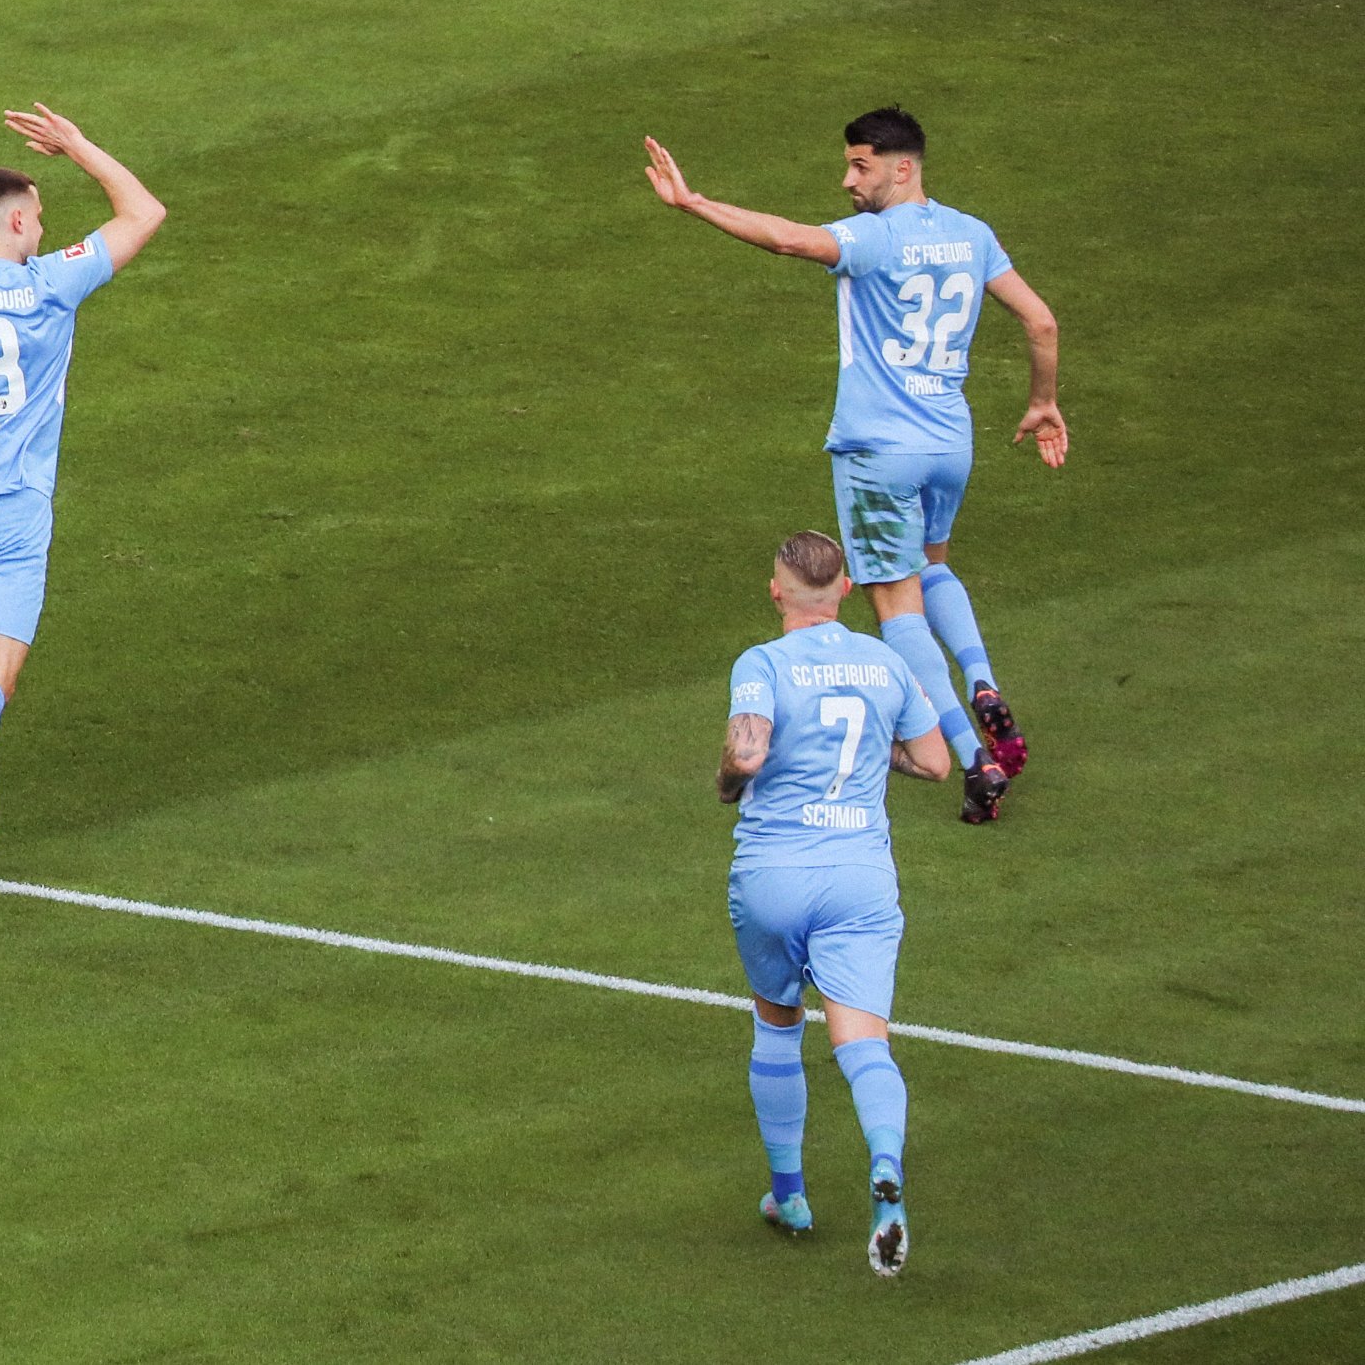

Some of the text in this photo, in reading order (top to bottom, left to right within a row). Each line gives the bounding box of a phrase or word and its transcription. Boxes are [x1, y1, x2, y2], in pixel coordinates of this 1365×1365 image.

[902, 241, 973, 266] SC FREIBURG
[881, 272, 974, 371] 32
[791, 664, 888, 688] SC FREIBURG
[820, 696, 866, 800] 7
[802, 803, 867, 829] SCHMID
